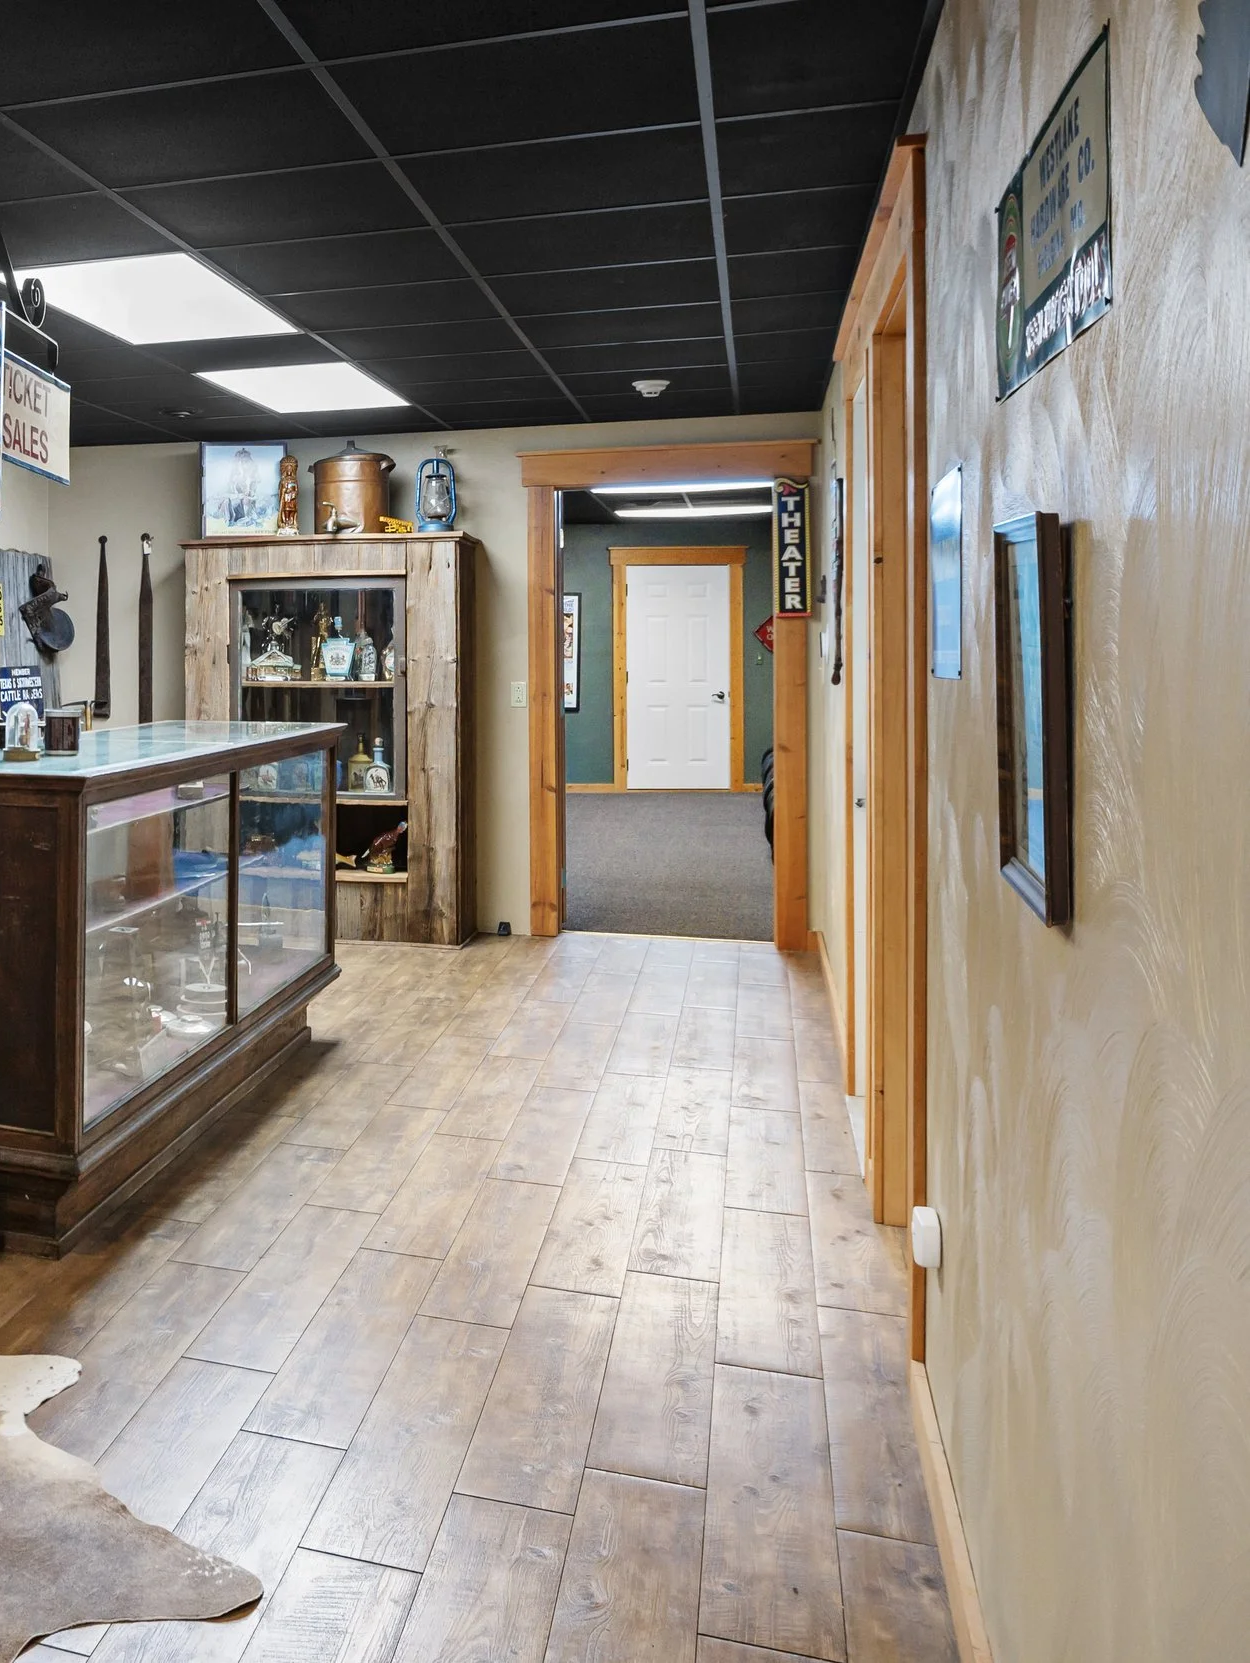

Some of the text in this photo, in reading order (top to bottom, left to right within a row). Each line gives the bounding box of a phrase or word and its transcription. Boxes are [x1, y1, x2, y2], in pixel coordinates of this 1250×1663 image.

[1039, 96, 1080, 190] WESTLAKE
[1078, 136, 1095, 184] CO.
[4, 362, 50, 418] TICKET
[3, 413, 49, 464] SALES
[780, 496, 803, 610] THEATER
[0, 689, 21, 702] CATTLE
